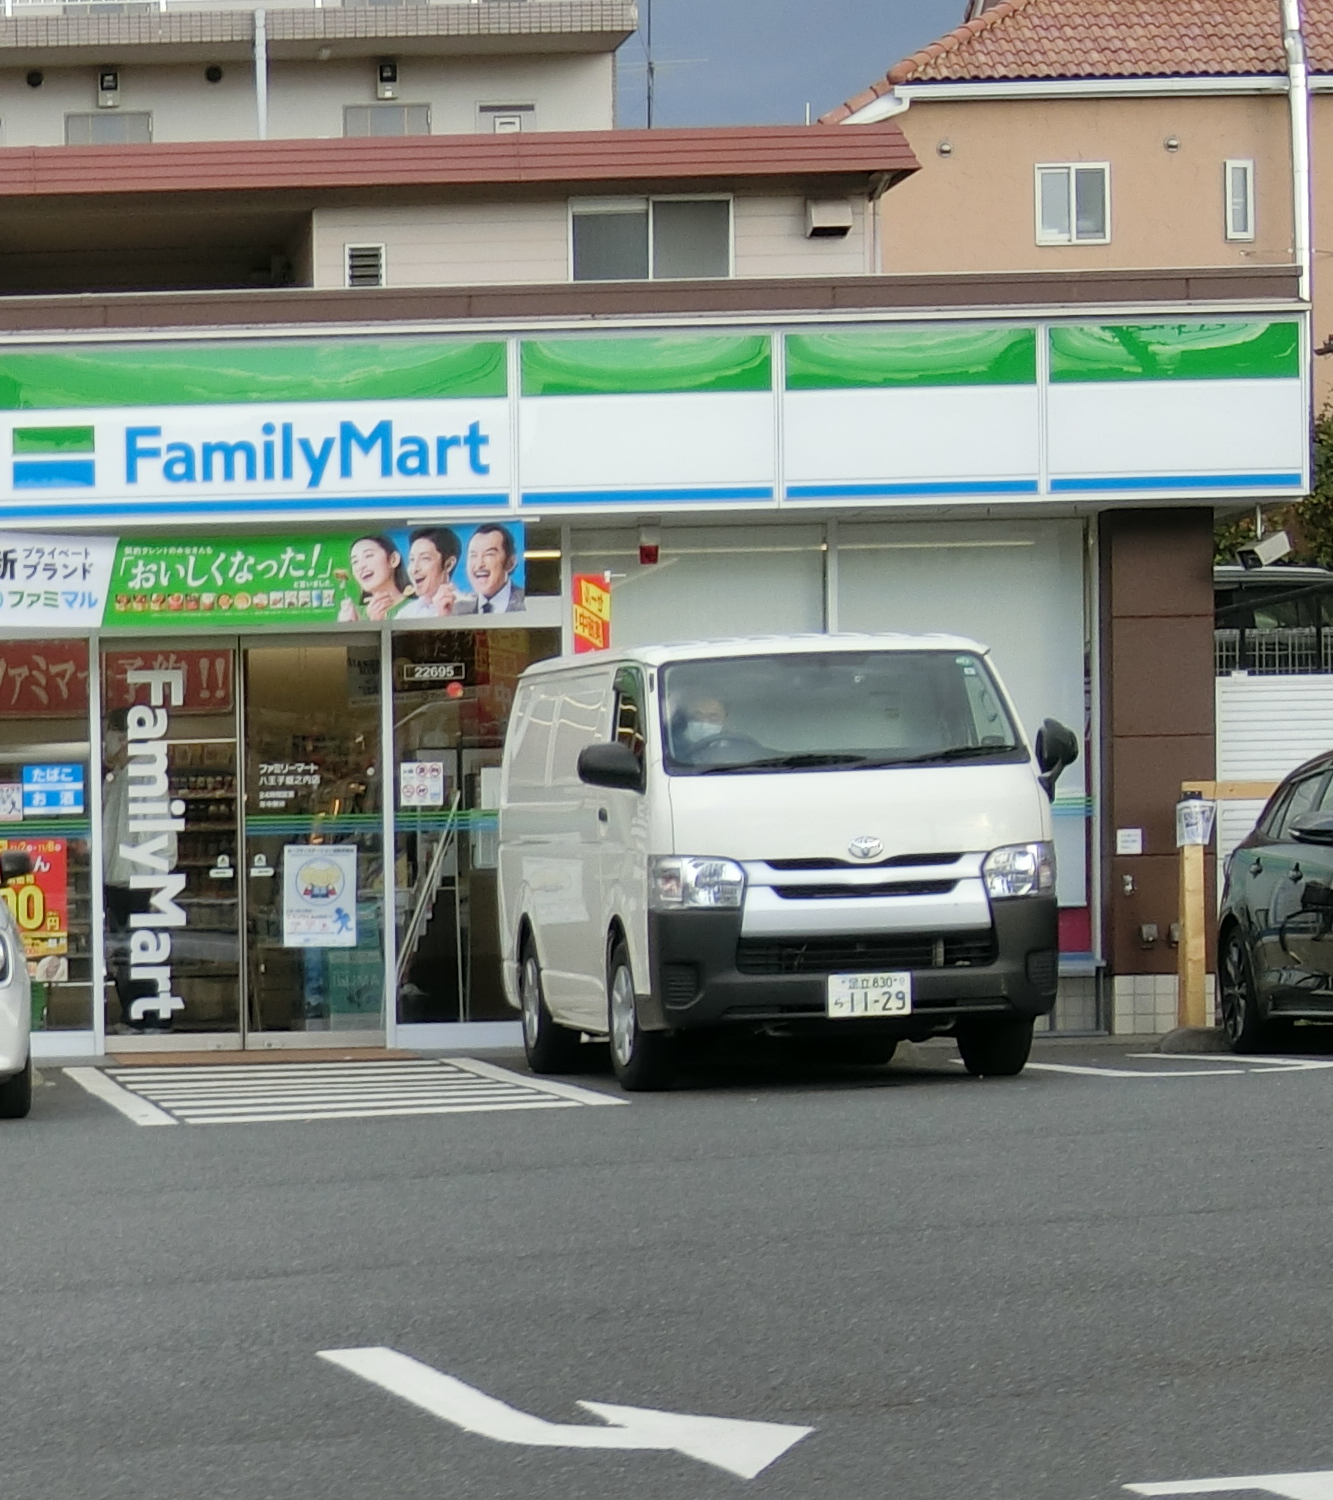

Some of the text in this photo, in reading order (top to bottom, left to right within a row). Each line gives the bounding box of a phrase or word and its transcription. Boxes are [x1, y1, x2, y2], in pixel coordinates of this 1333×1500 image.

[125, 420, 490, 488] FamilyMart
[22, 546, 90, 560] プライベート
[23, 561, 94, 581] ブランド
[8, 590, 98, 609] ファミマル
[414, 665, 455, 679] 22695
[32, 768, 73, 783] たばこ
[259, 763, 319, 774] ファミリーマート
[119, 669, 187, 1020] FamilyMart
[850, 990, 906, 1013] 11-29
